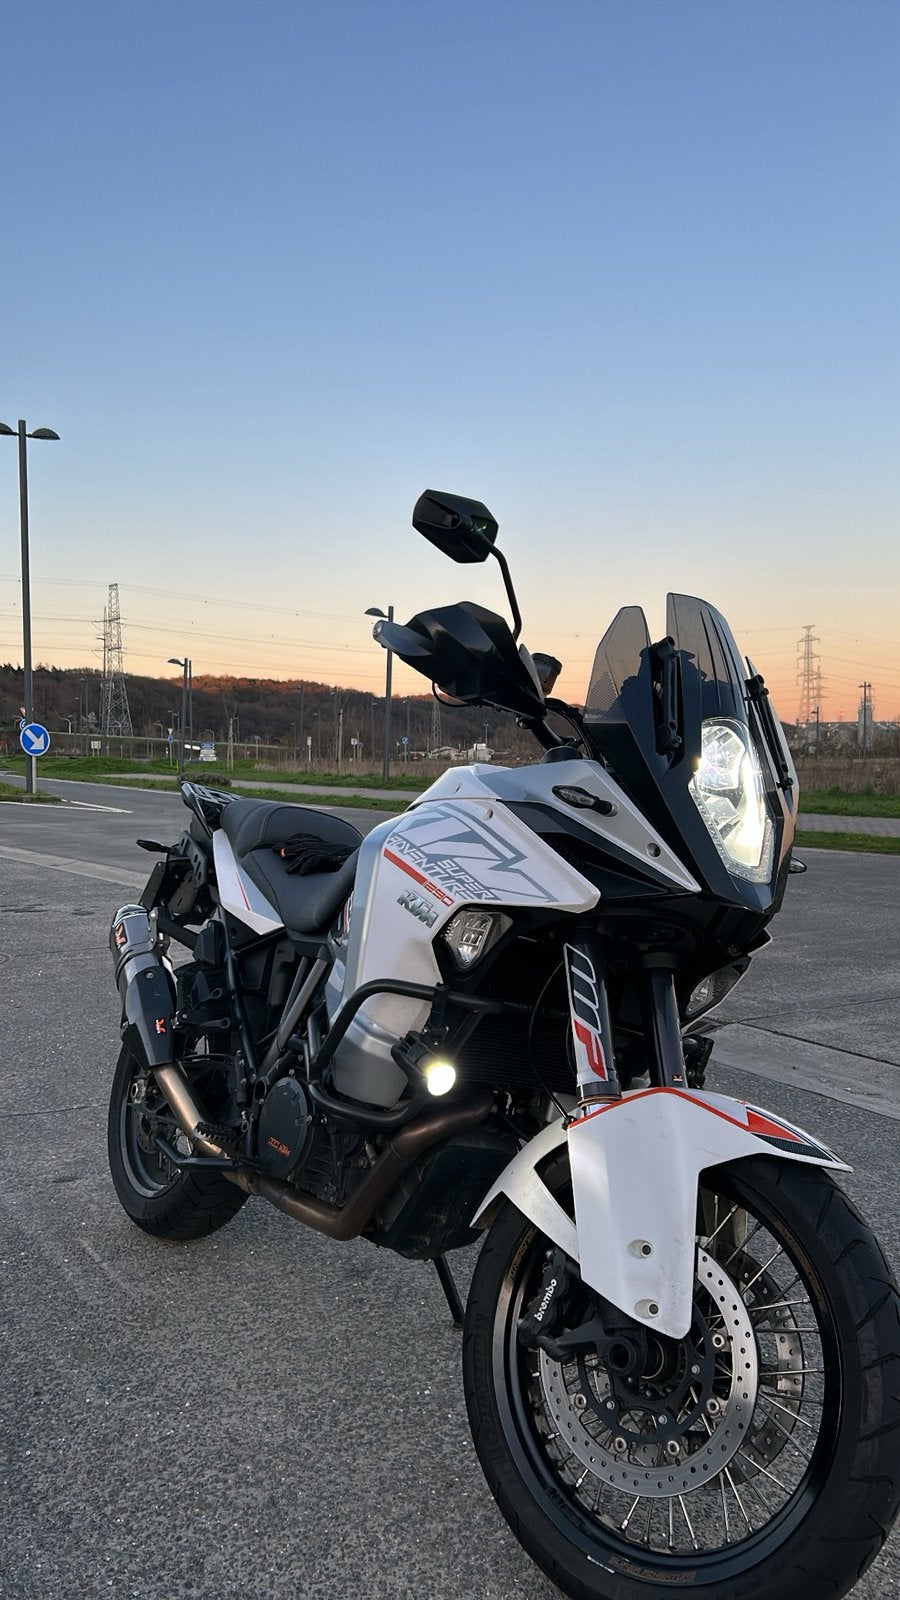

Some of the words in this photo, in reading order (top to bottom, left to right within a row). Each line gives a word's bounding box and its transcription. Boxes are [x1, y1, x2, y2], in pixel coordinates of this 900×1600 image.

[386, 835, 478, 901] ADVENTURE
[436, 858, 496, 901] SUPER
[396, 890, 440, 929] KTM
[423, 880, 456, 908] 1290
[533, 1278, 558, 1322] brembo
